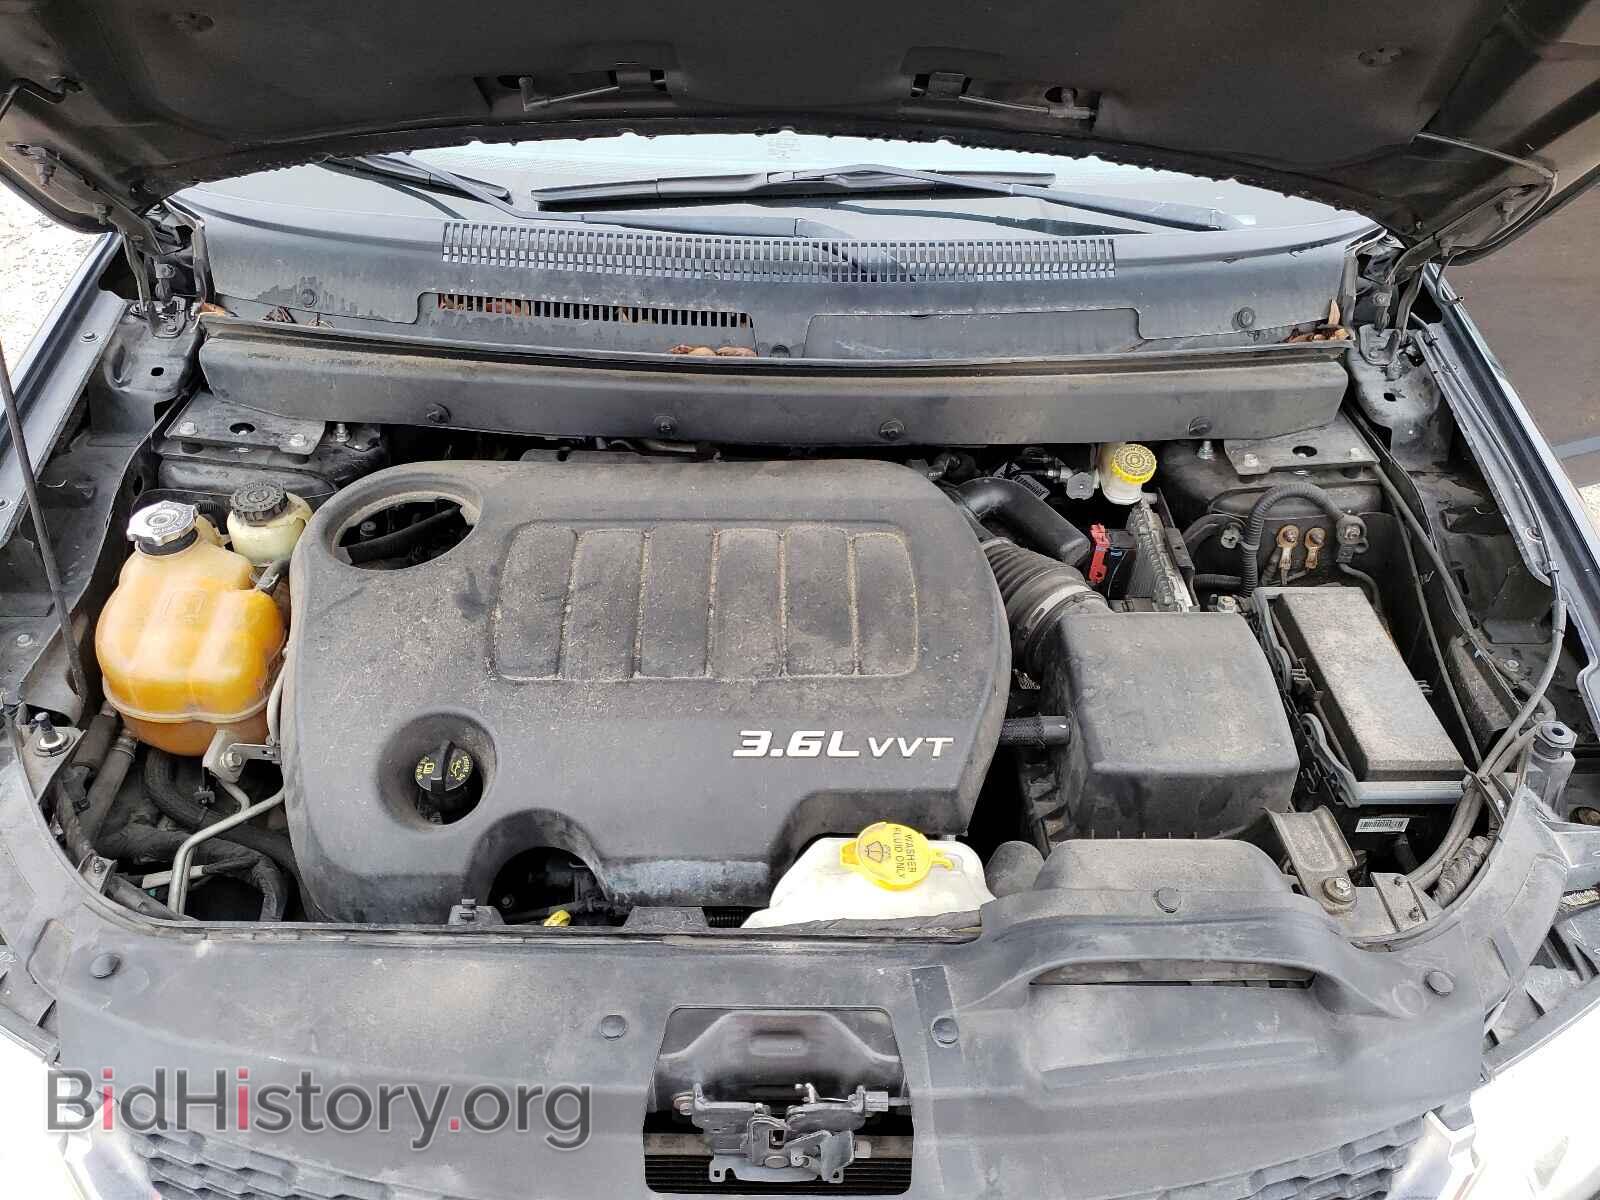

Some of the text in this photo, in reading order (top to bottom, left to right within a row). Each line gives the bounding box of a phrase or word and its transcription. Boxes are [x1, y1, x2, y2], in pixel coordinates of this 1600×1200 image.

[732, 730, 955, 758] 3.6L VVT
[893, 827, 906, 879] FLUID ONLY
[904, 834, 917, 873] WASHER
